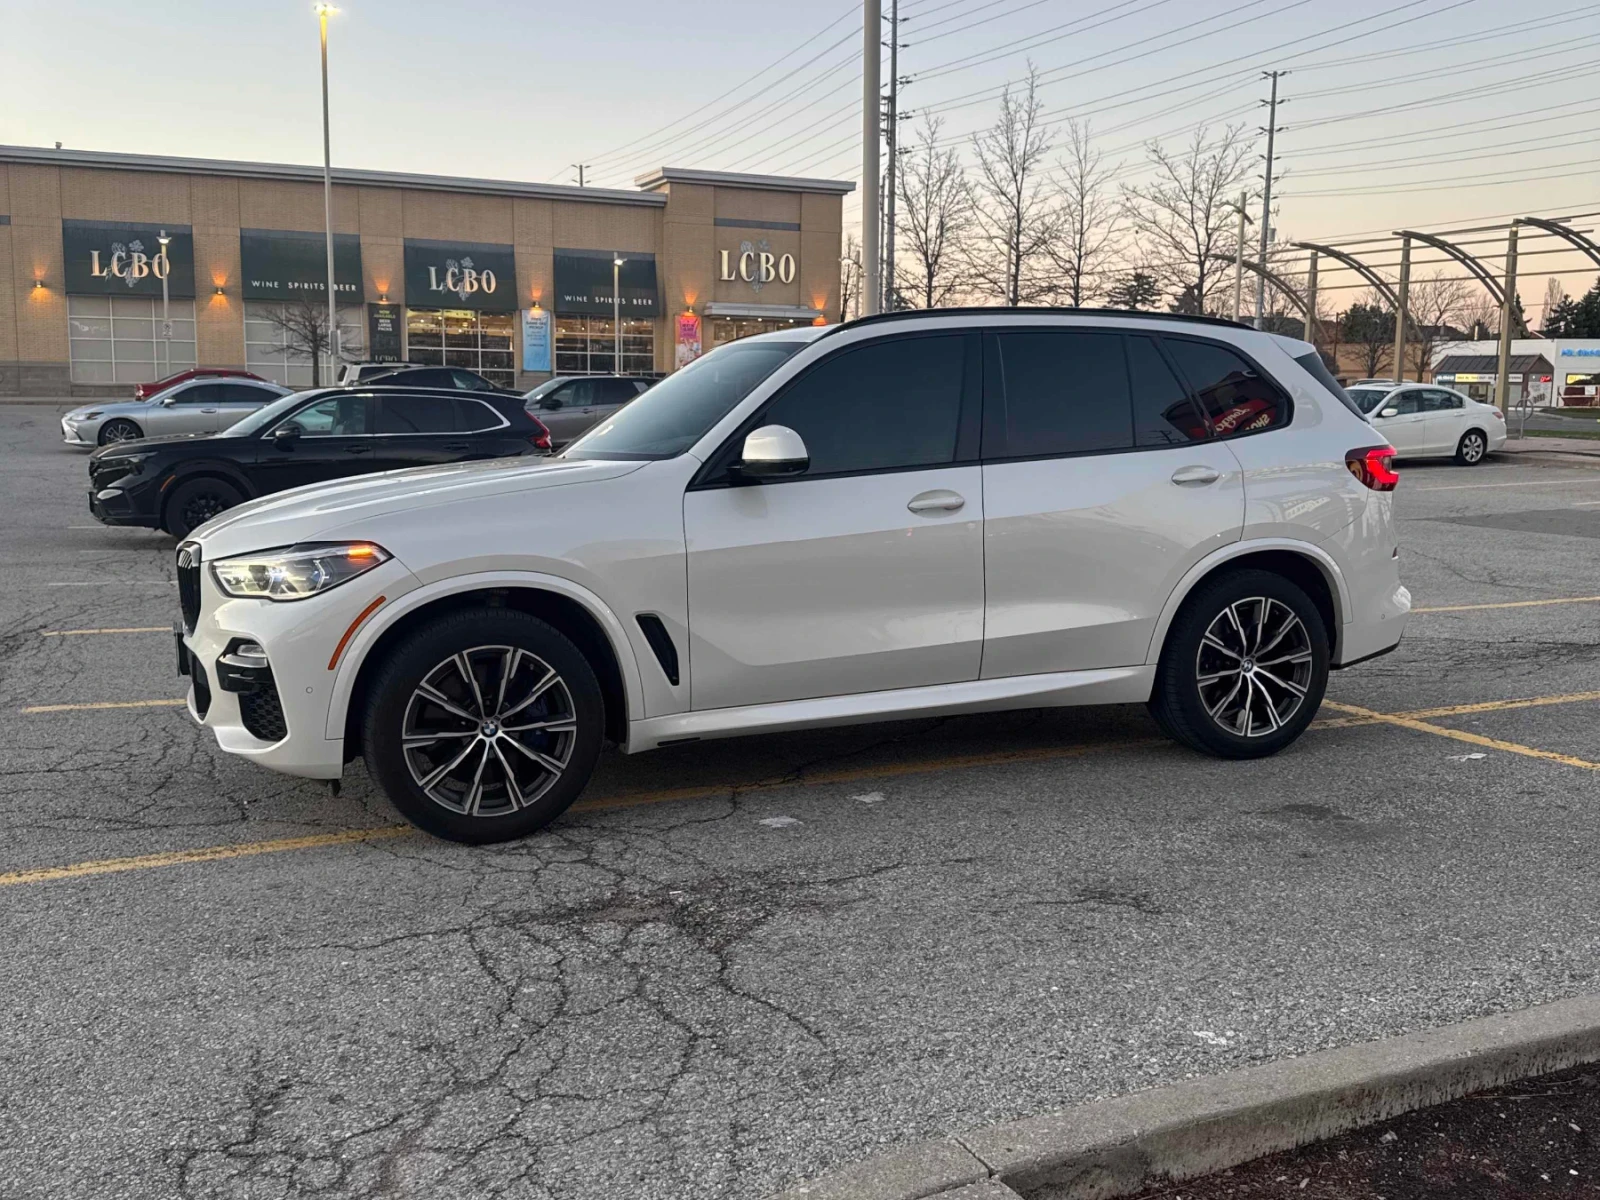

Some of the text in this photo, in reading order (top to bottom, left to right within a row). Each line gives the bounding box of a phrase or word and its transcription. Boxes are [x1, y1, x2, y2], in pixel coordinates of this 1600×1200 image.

[90, 249, 170, 279] LCBO
[719, 249, 796, 284] LCBO
[251, 280, 357, 292] WINE SPIRITS BEER
[427, 265, 497, 294] LCBO
[564, 295, 588, 303] WINE
[633, 298, 653, 306] BEER
